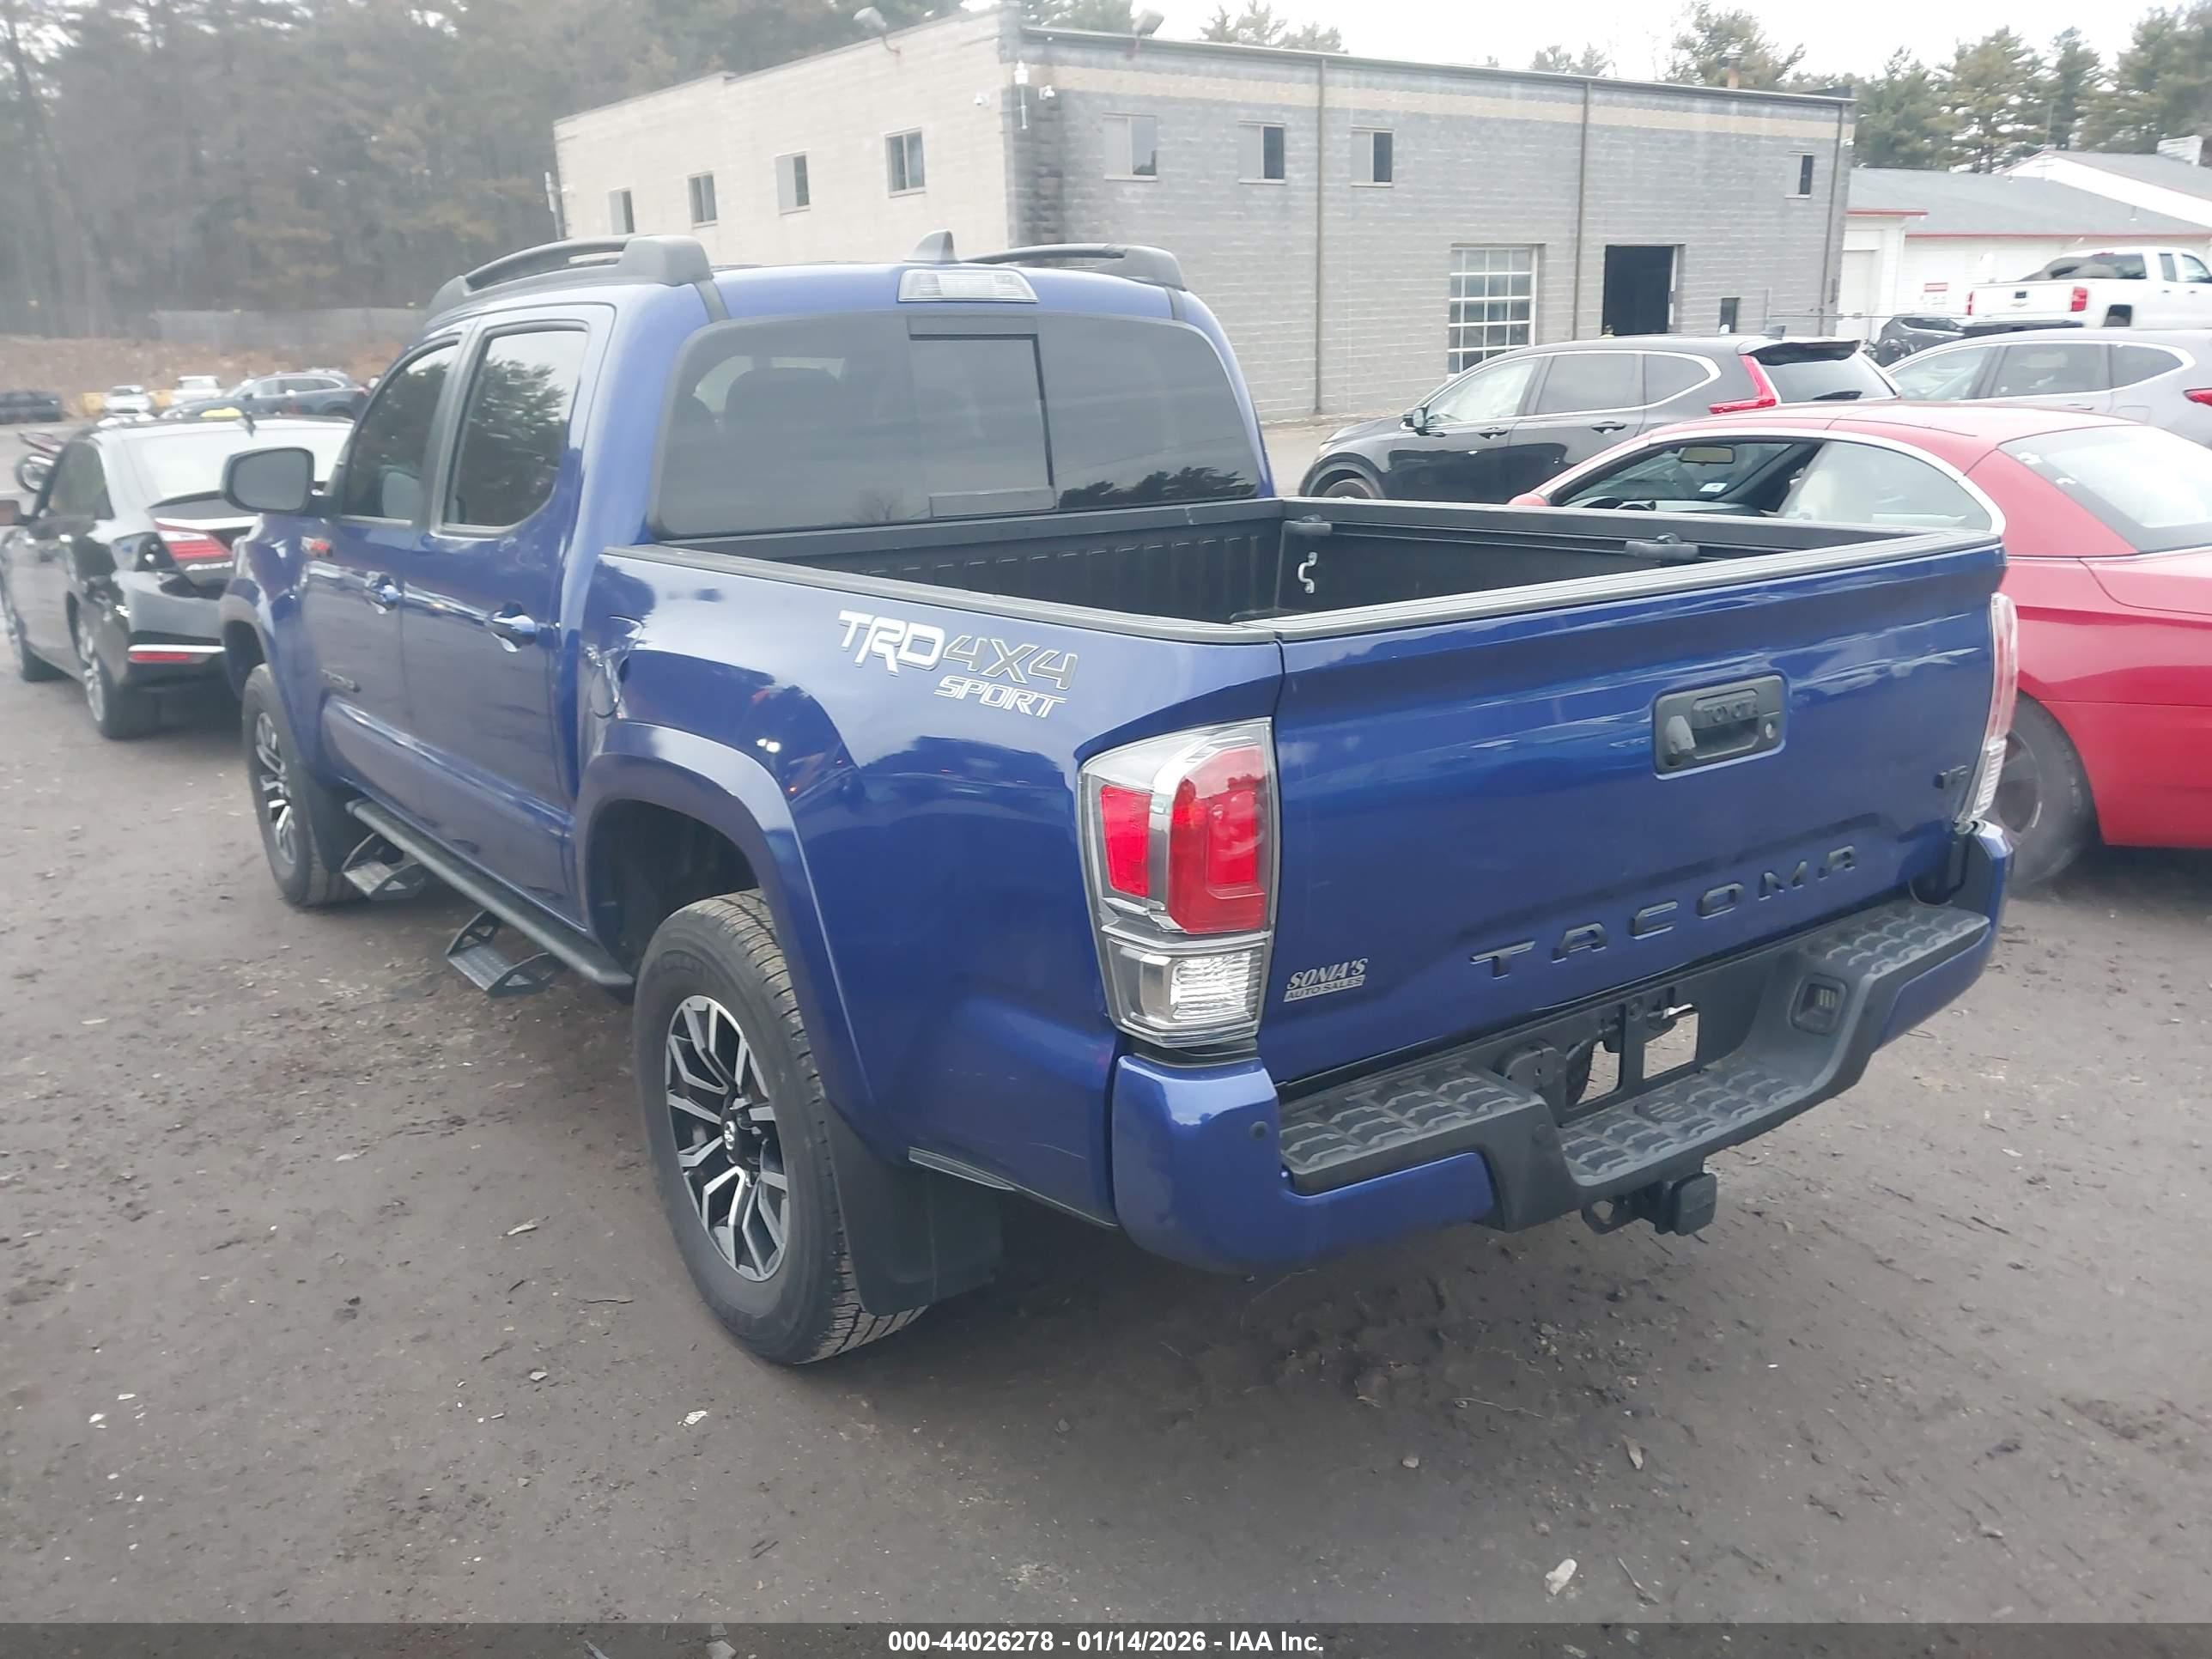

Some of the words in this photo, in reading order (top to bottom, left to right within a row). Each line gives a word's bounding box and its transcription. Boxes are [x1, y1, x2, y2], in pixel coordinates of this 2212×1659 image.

[839, 610, 945, 676] TRD
[933, 675, 1067, 718] SPORT
[1470, 845, 1856, 979] TACOMA
[1286, 958, 1369, 989] SONIA'S
[1288, 987, 1321, 1000] AUTO
[1323, 976, 1362, 992] SALES
